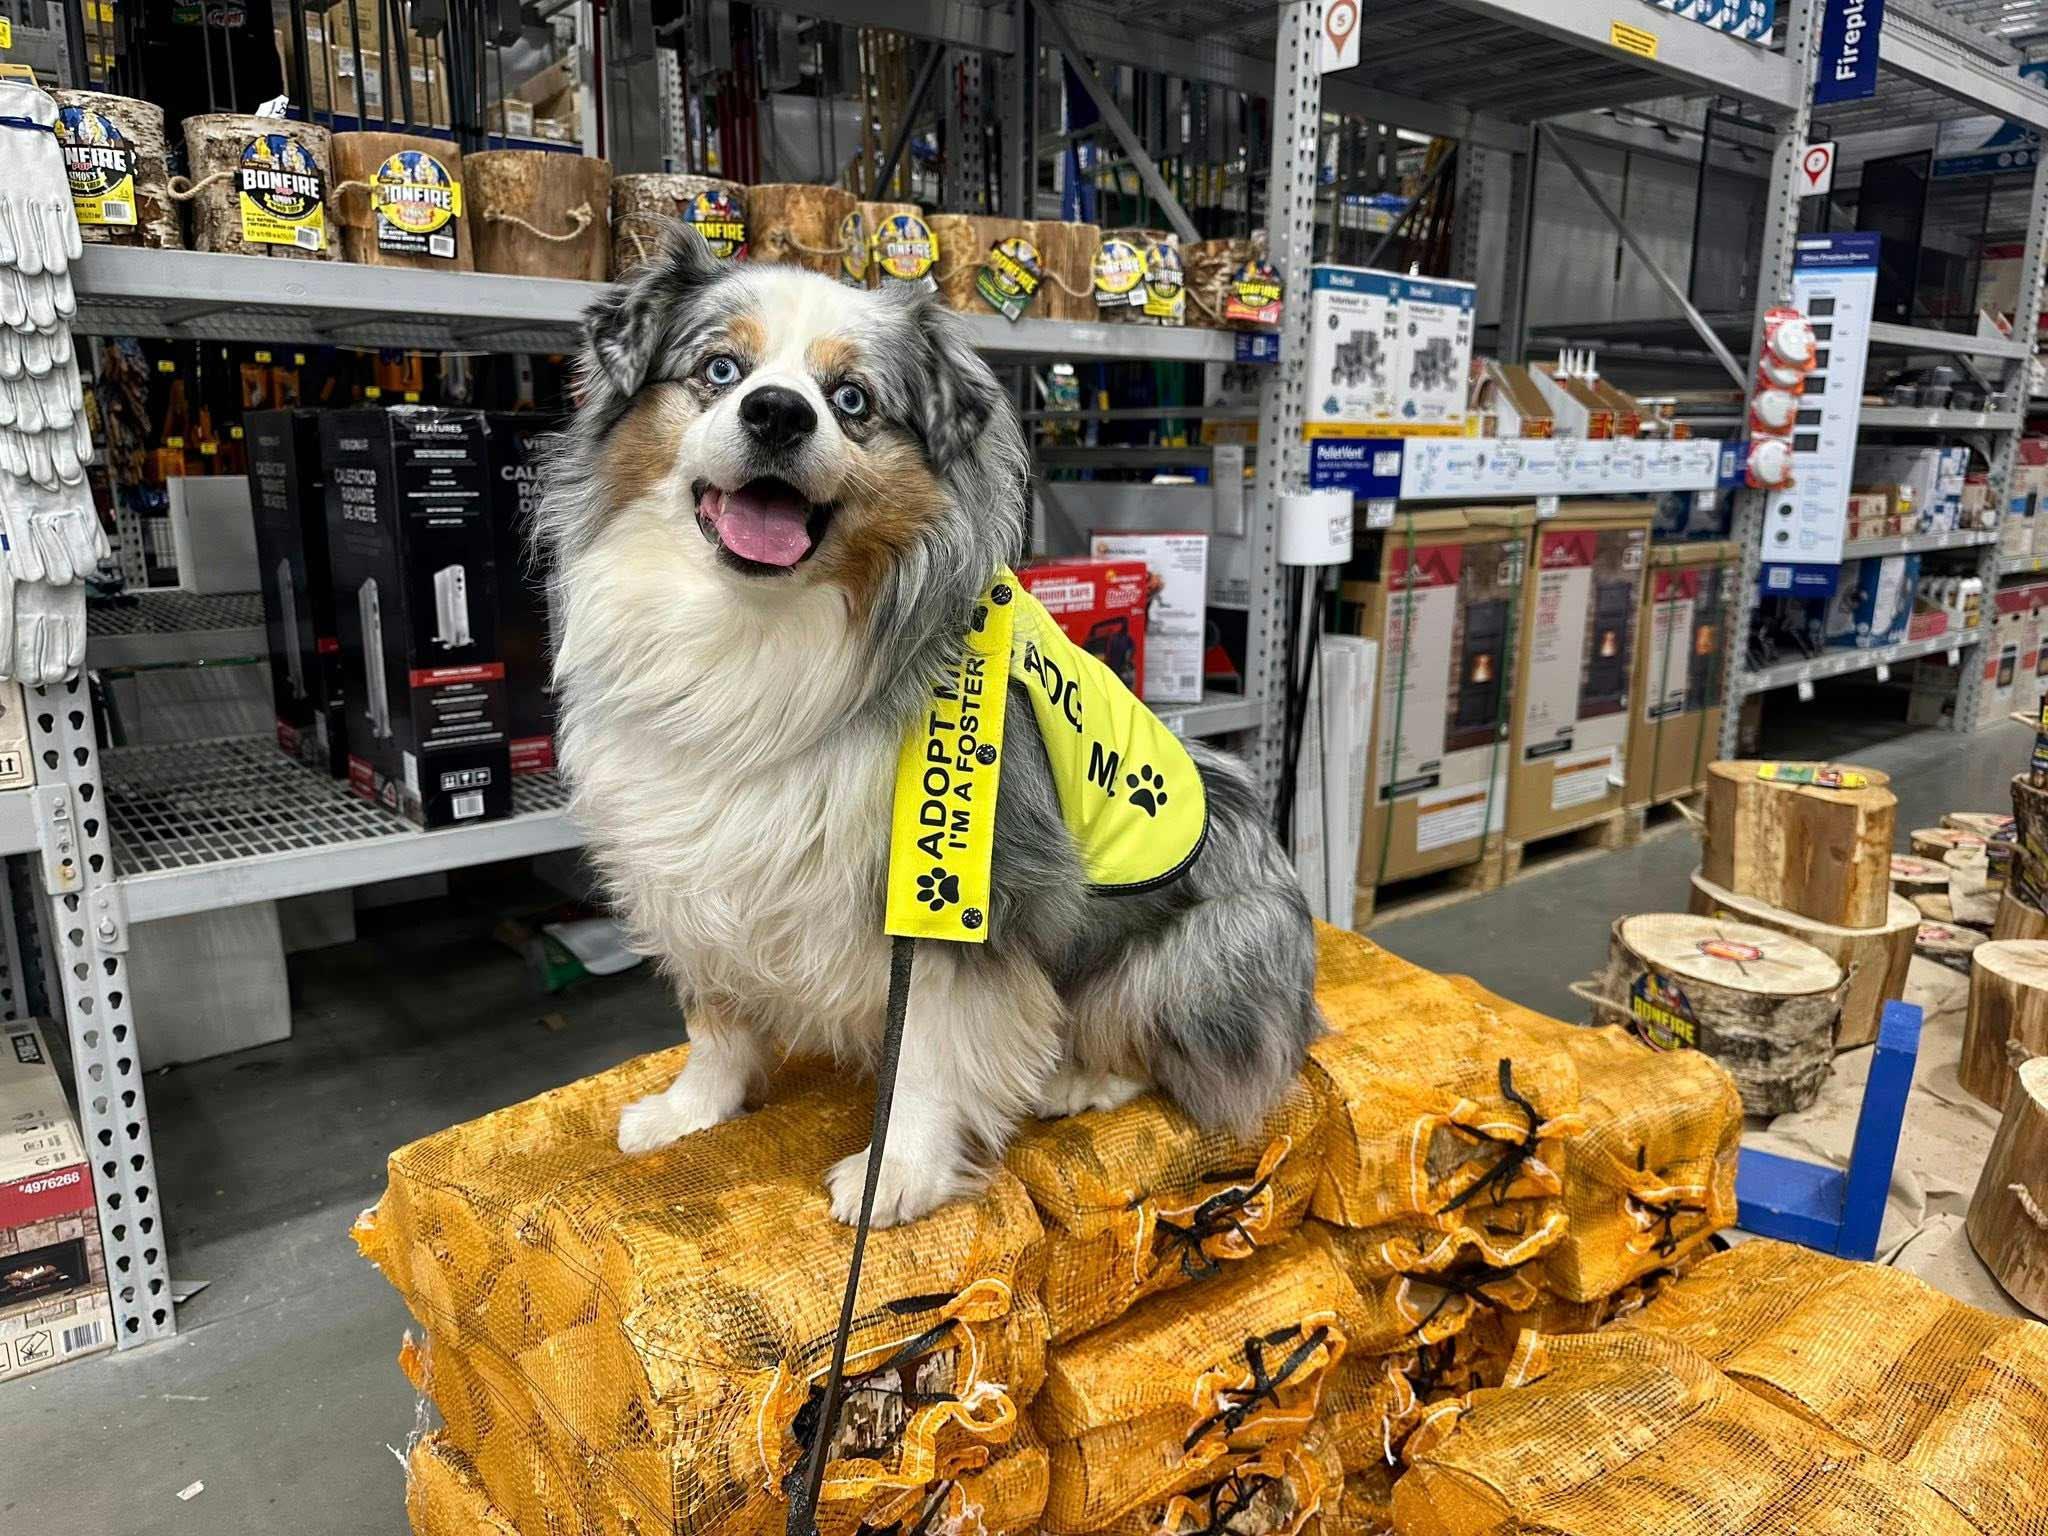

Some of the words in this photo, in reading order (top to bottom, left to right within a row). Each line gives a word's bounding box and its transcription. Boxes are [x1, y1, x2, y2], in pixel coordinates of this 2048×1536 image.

[65, 147, 127, 172] NFIRE
[242, 168, 320, 199] BONFIRE
[415, 424, 464, 433] FEATURES
[956, 656, 986, 774] FOSTER
[916, 709, 956, 860] ADOPT
[953, 781, 973, 803] A
[948, 809, 971, 850] I'M
[1633, 995, 1695, 1046] BONFIRE
